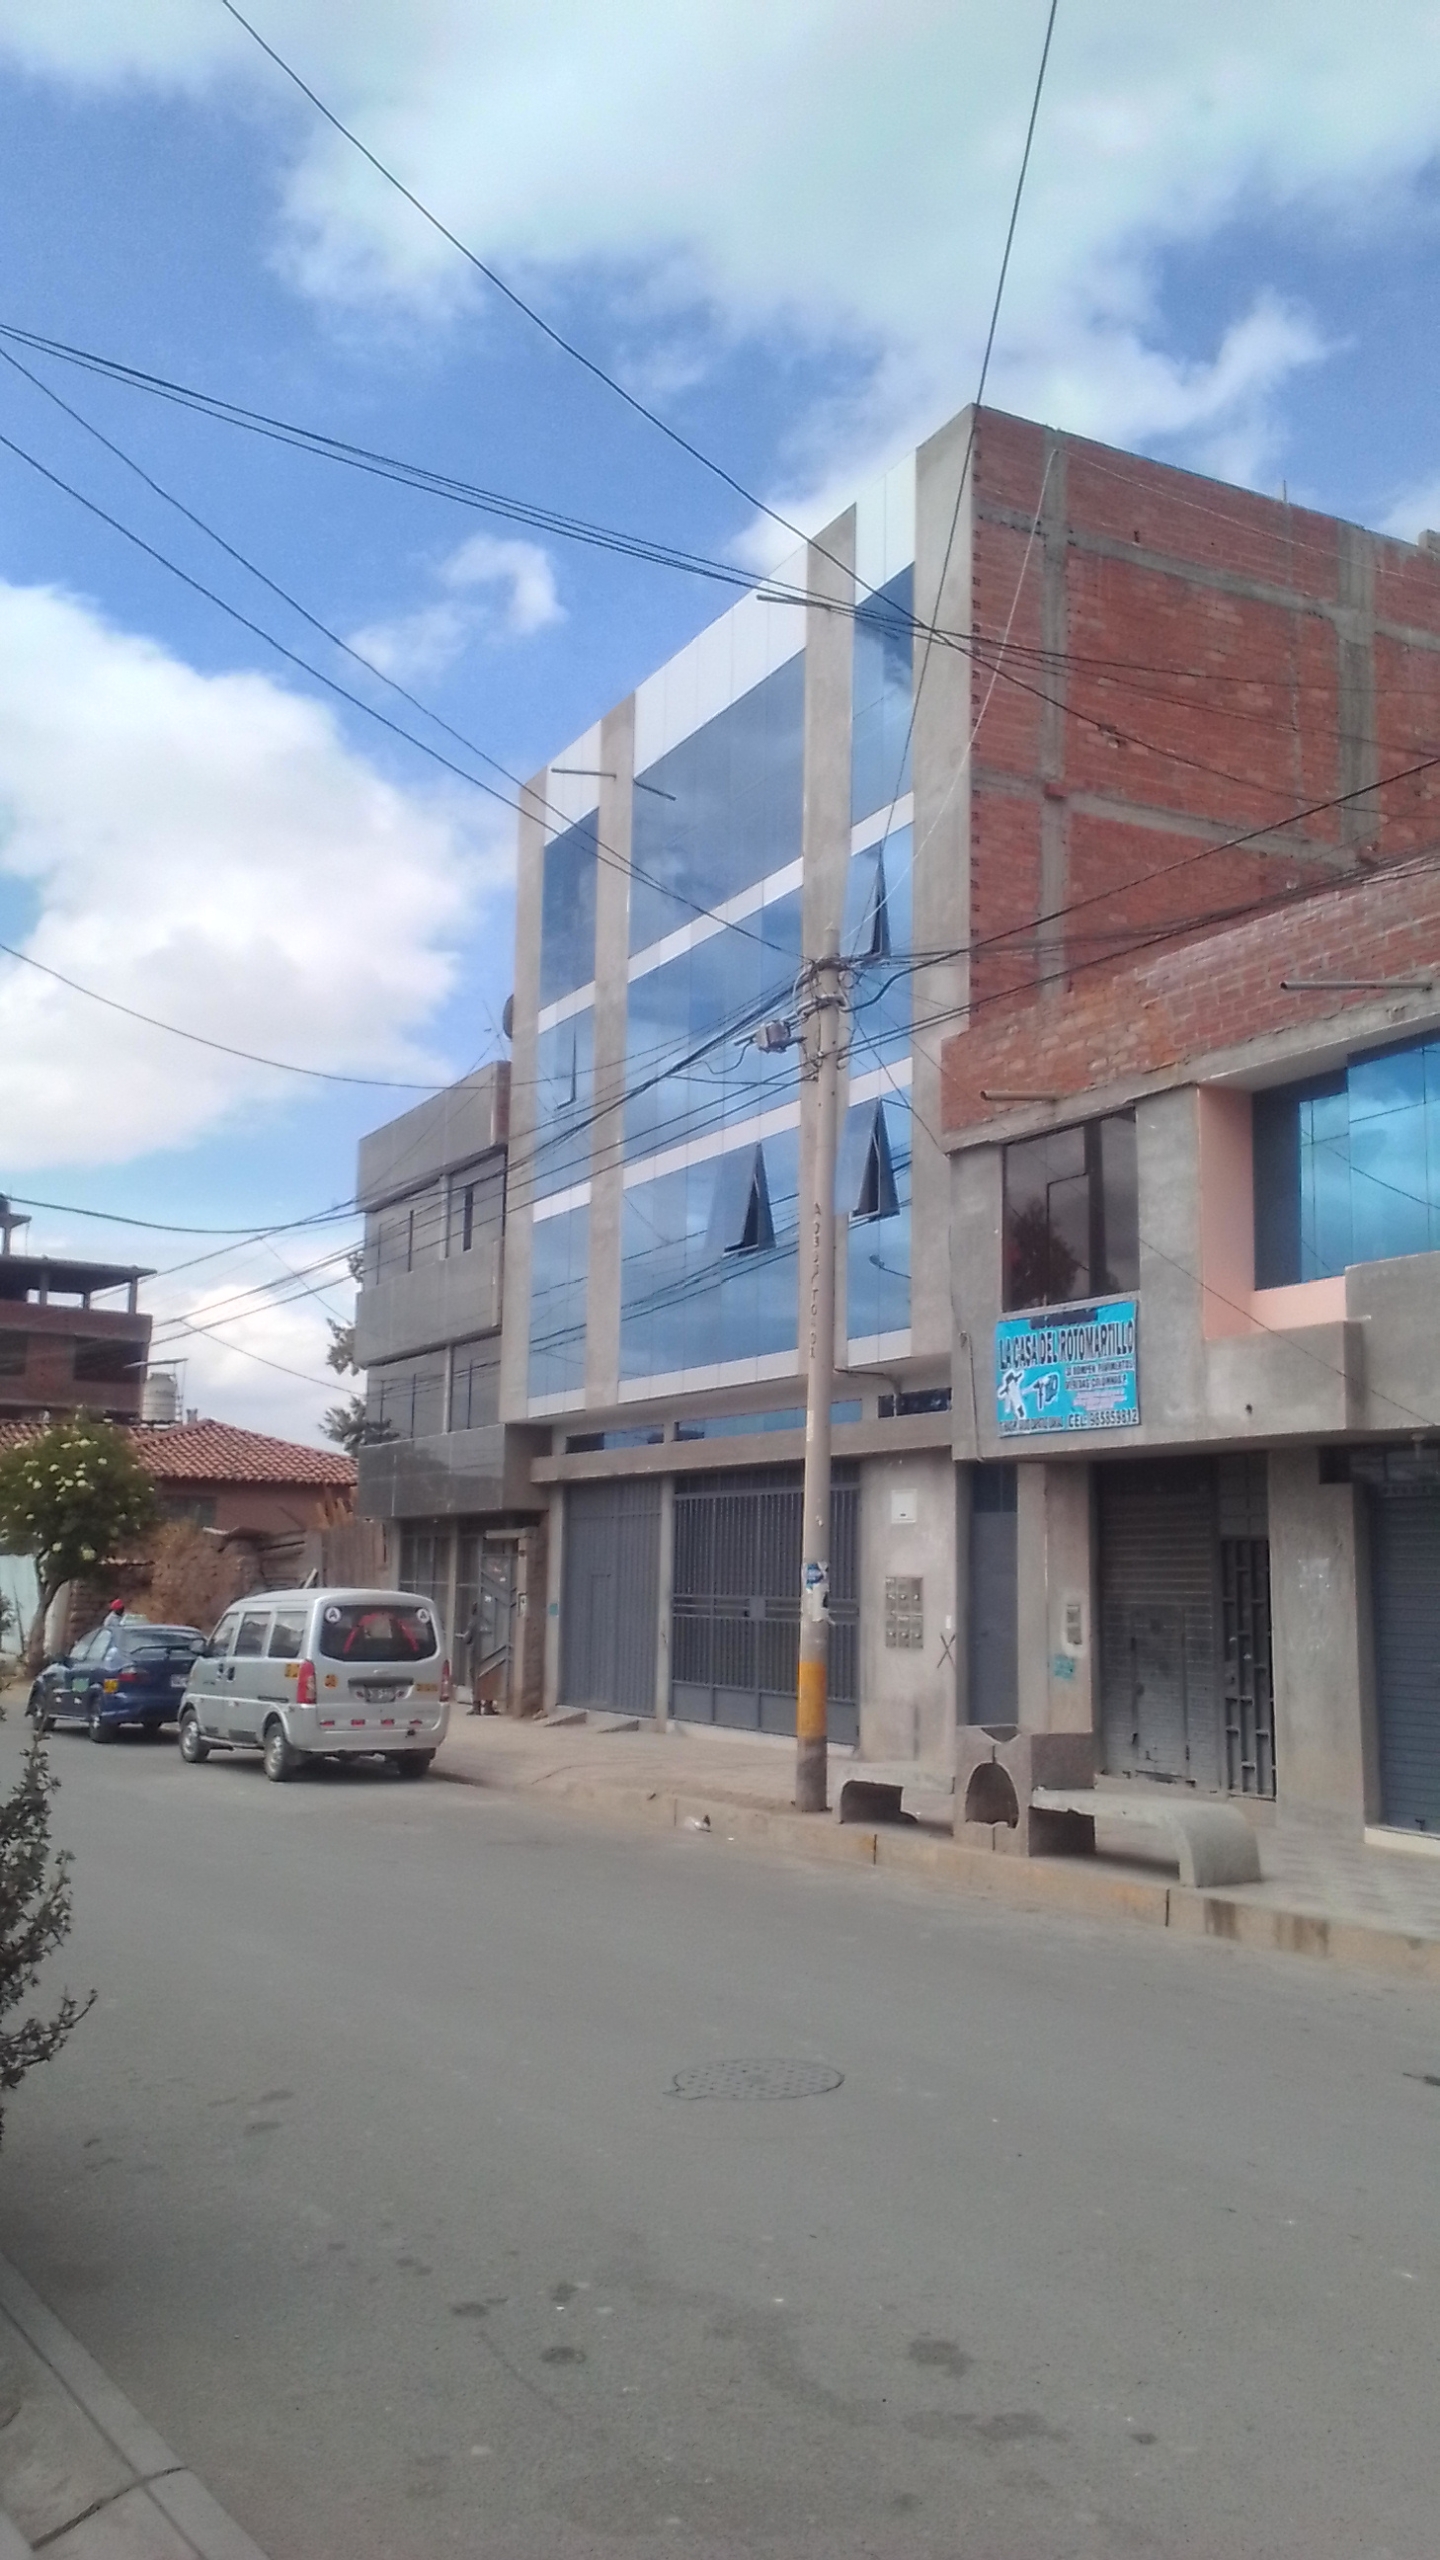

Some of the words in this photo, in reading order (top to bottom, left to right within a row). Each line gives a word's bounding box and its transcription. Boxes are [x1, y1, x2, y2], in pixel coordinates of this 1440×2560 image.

[1000, 1338, 1011, 1369] LA
[1013, 1334, 1038, 1367] CASA
[1040, 1330, 1058, 1364] DEL
[1059, 1320, 1134, 1362] ROTOMARTILLO
